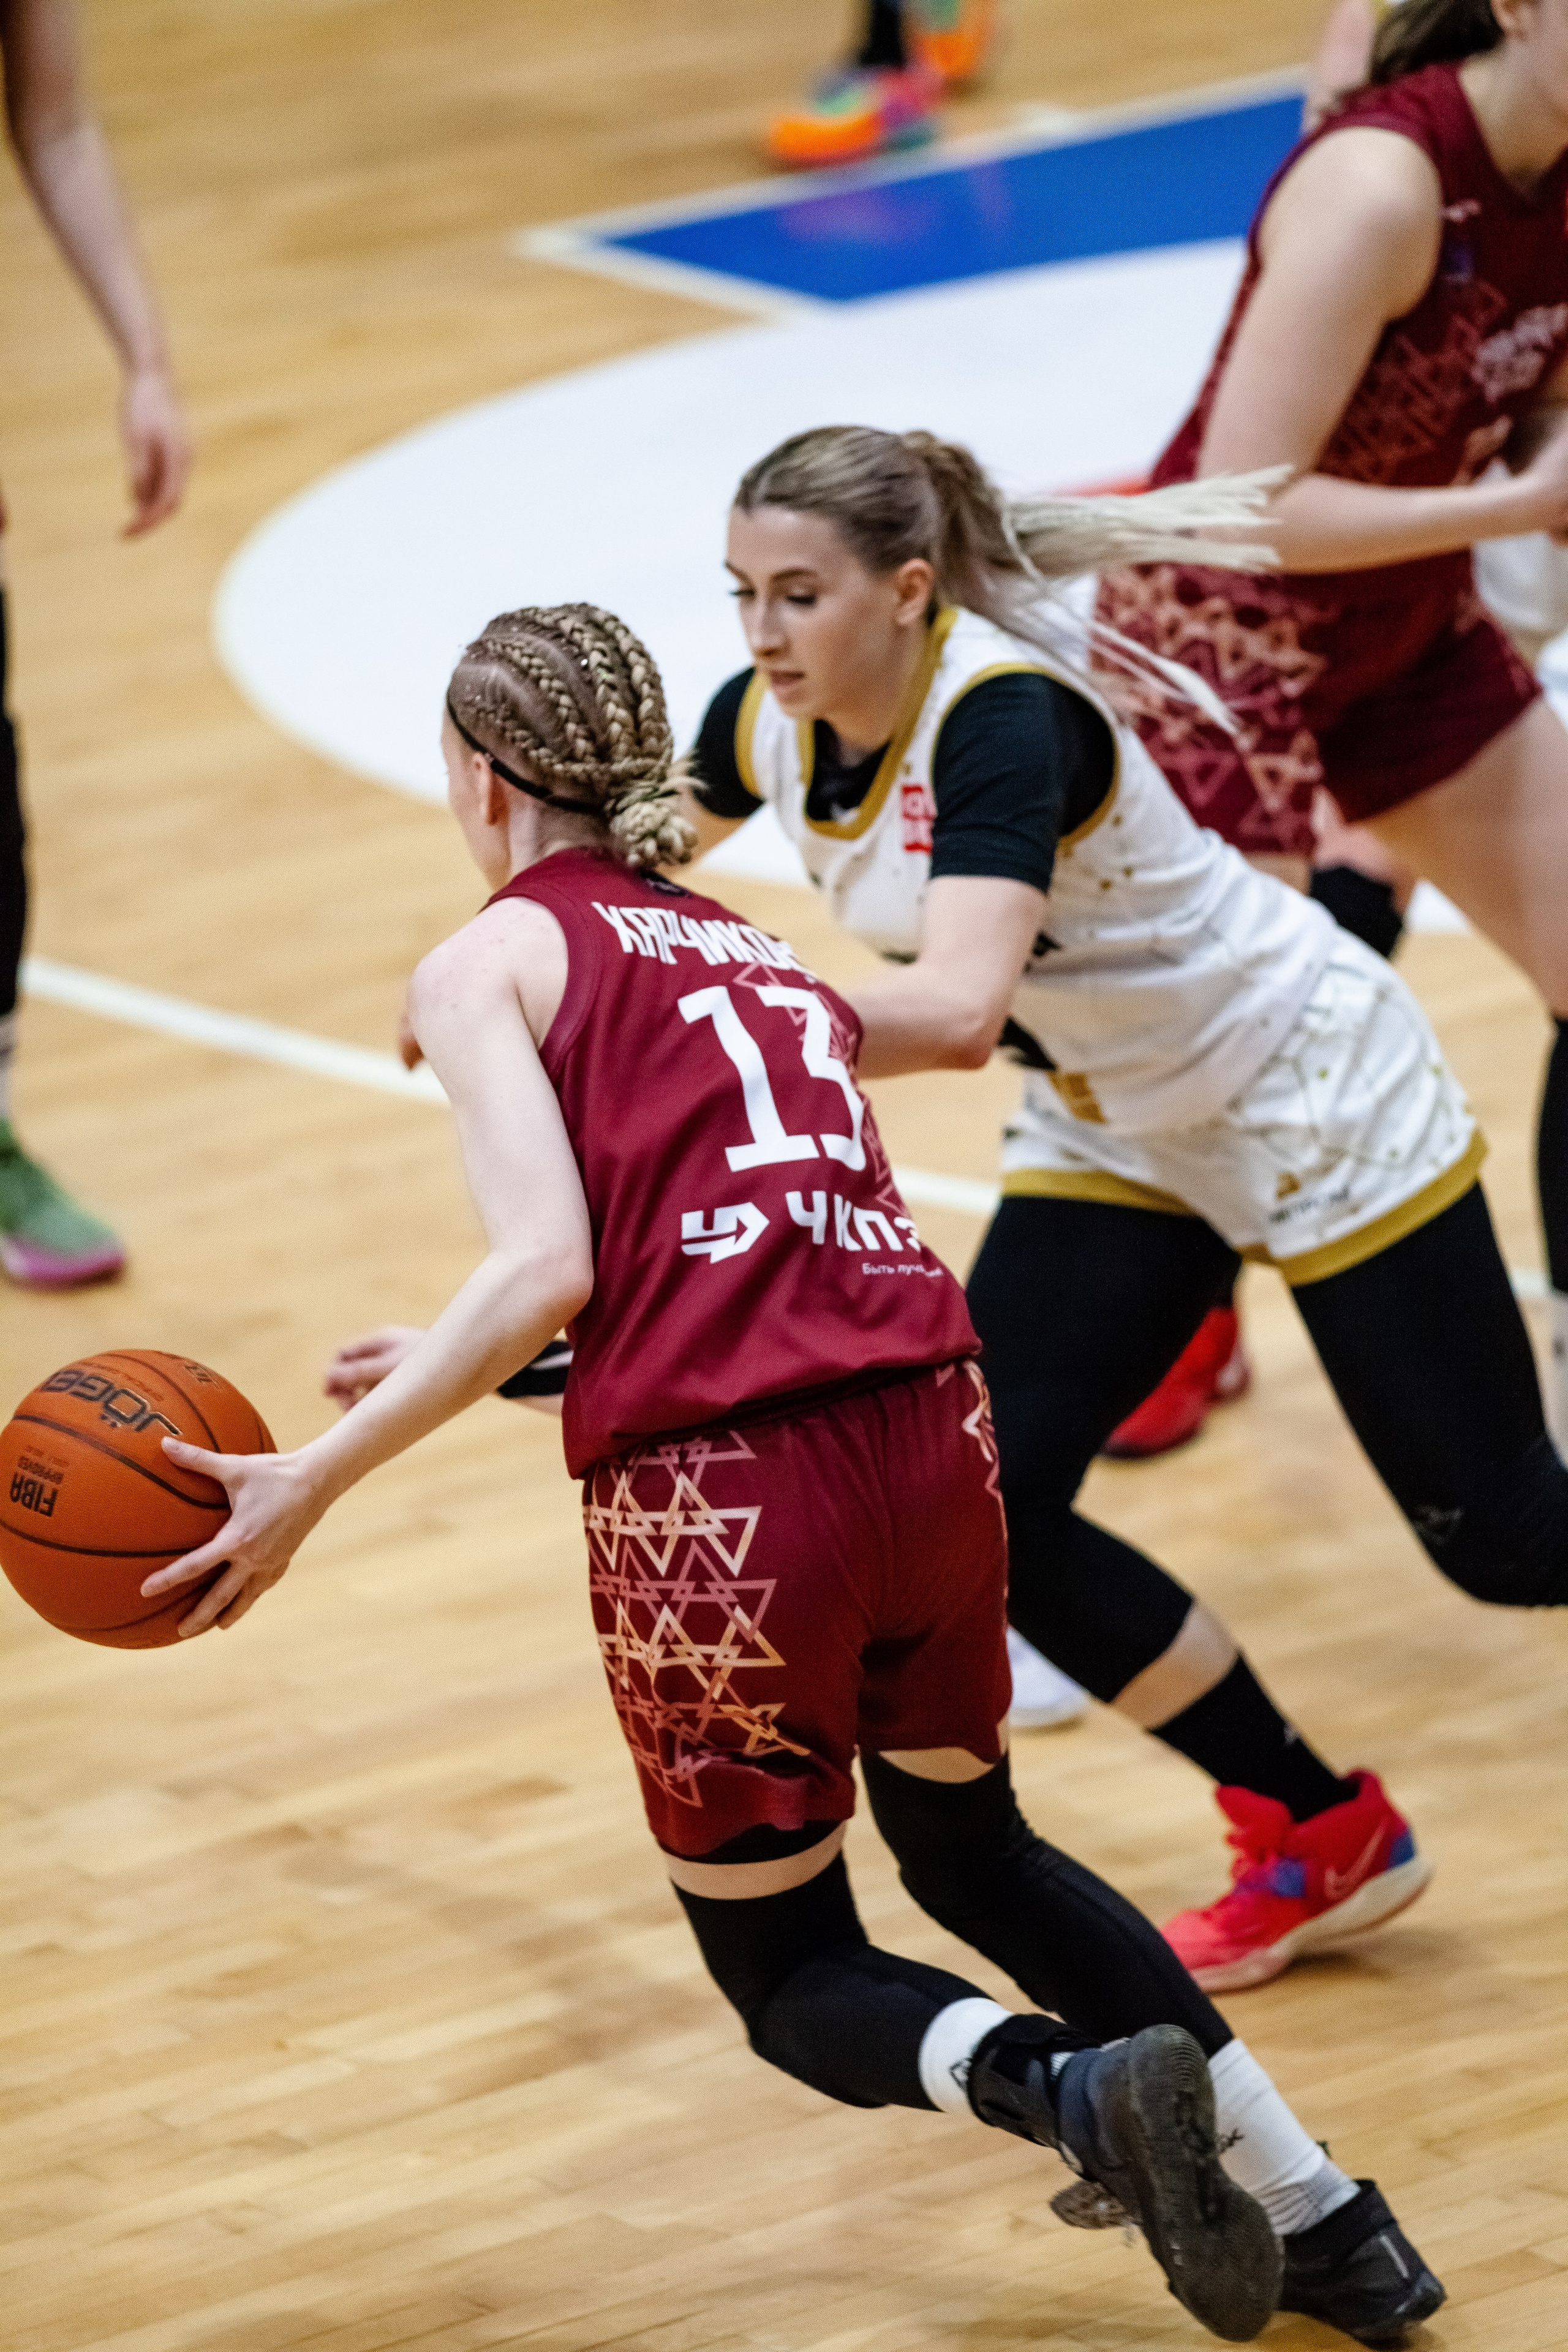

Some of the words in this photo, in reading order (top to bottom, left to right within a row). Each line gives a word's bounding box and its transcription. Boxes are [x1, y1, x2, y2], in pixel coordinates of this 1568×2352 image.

[677, 986, 867, 1172] 13
[862, 1262, 895, 1275] Быть
[9, 1472, 58, 1517] FIBA
